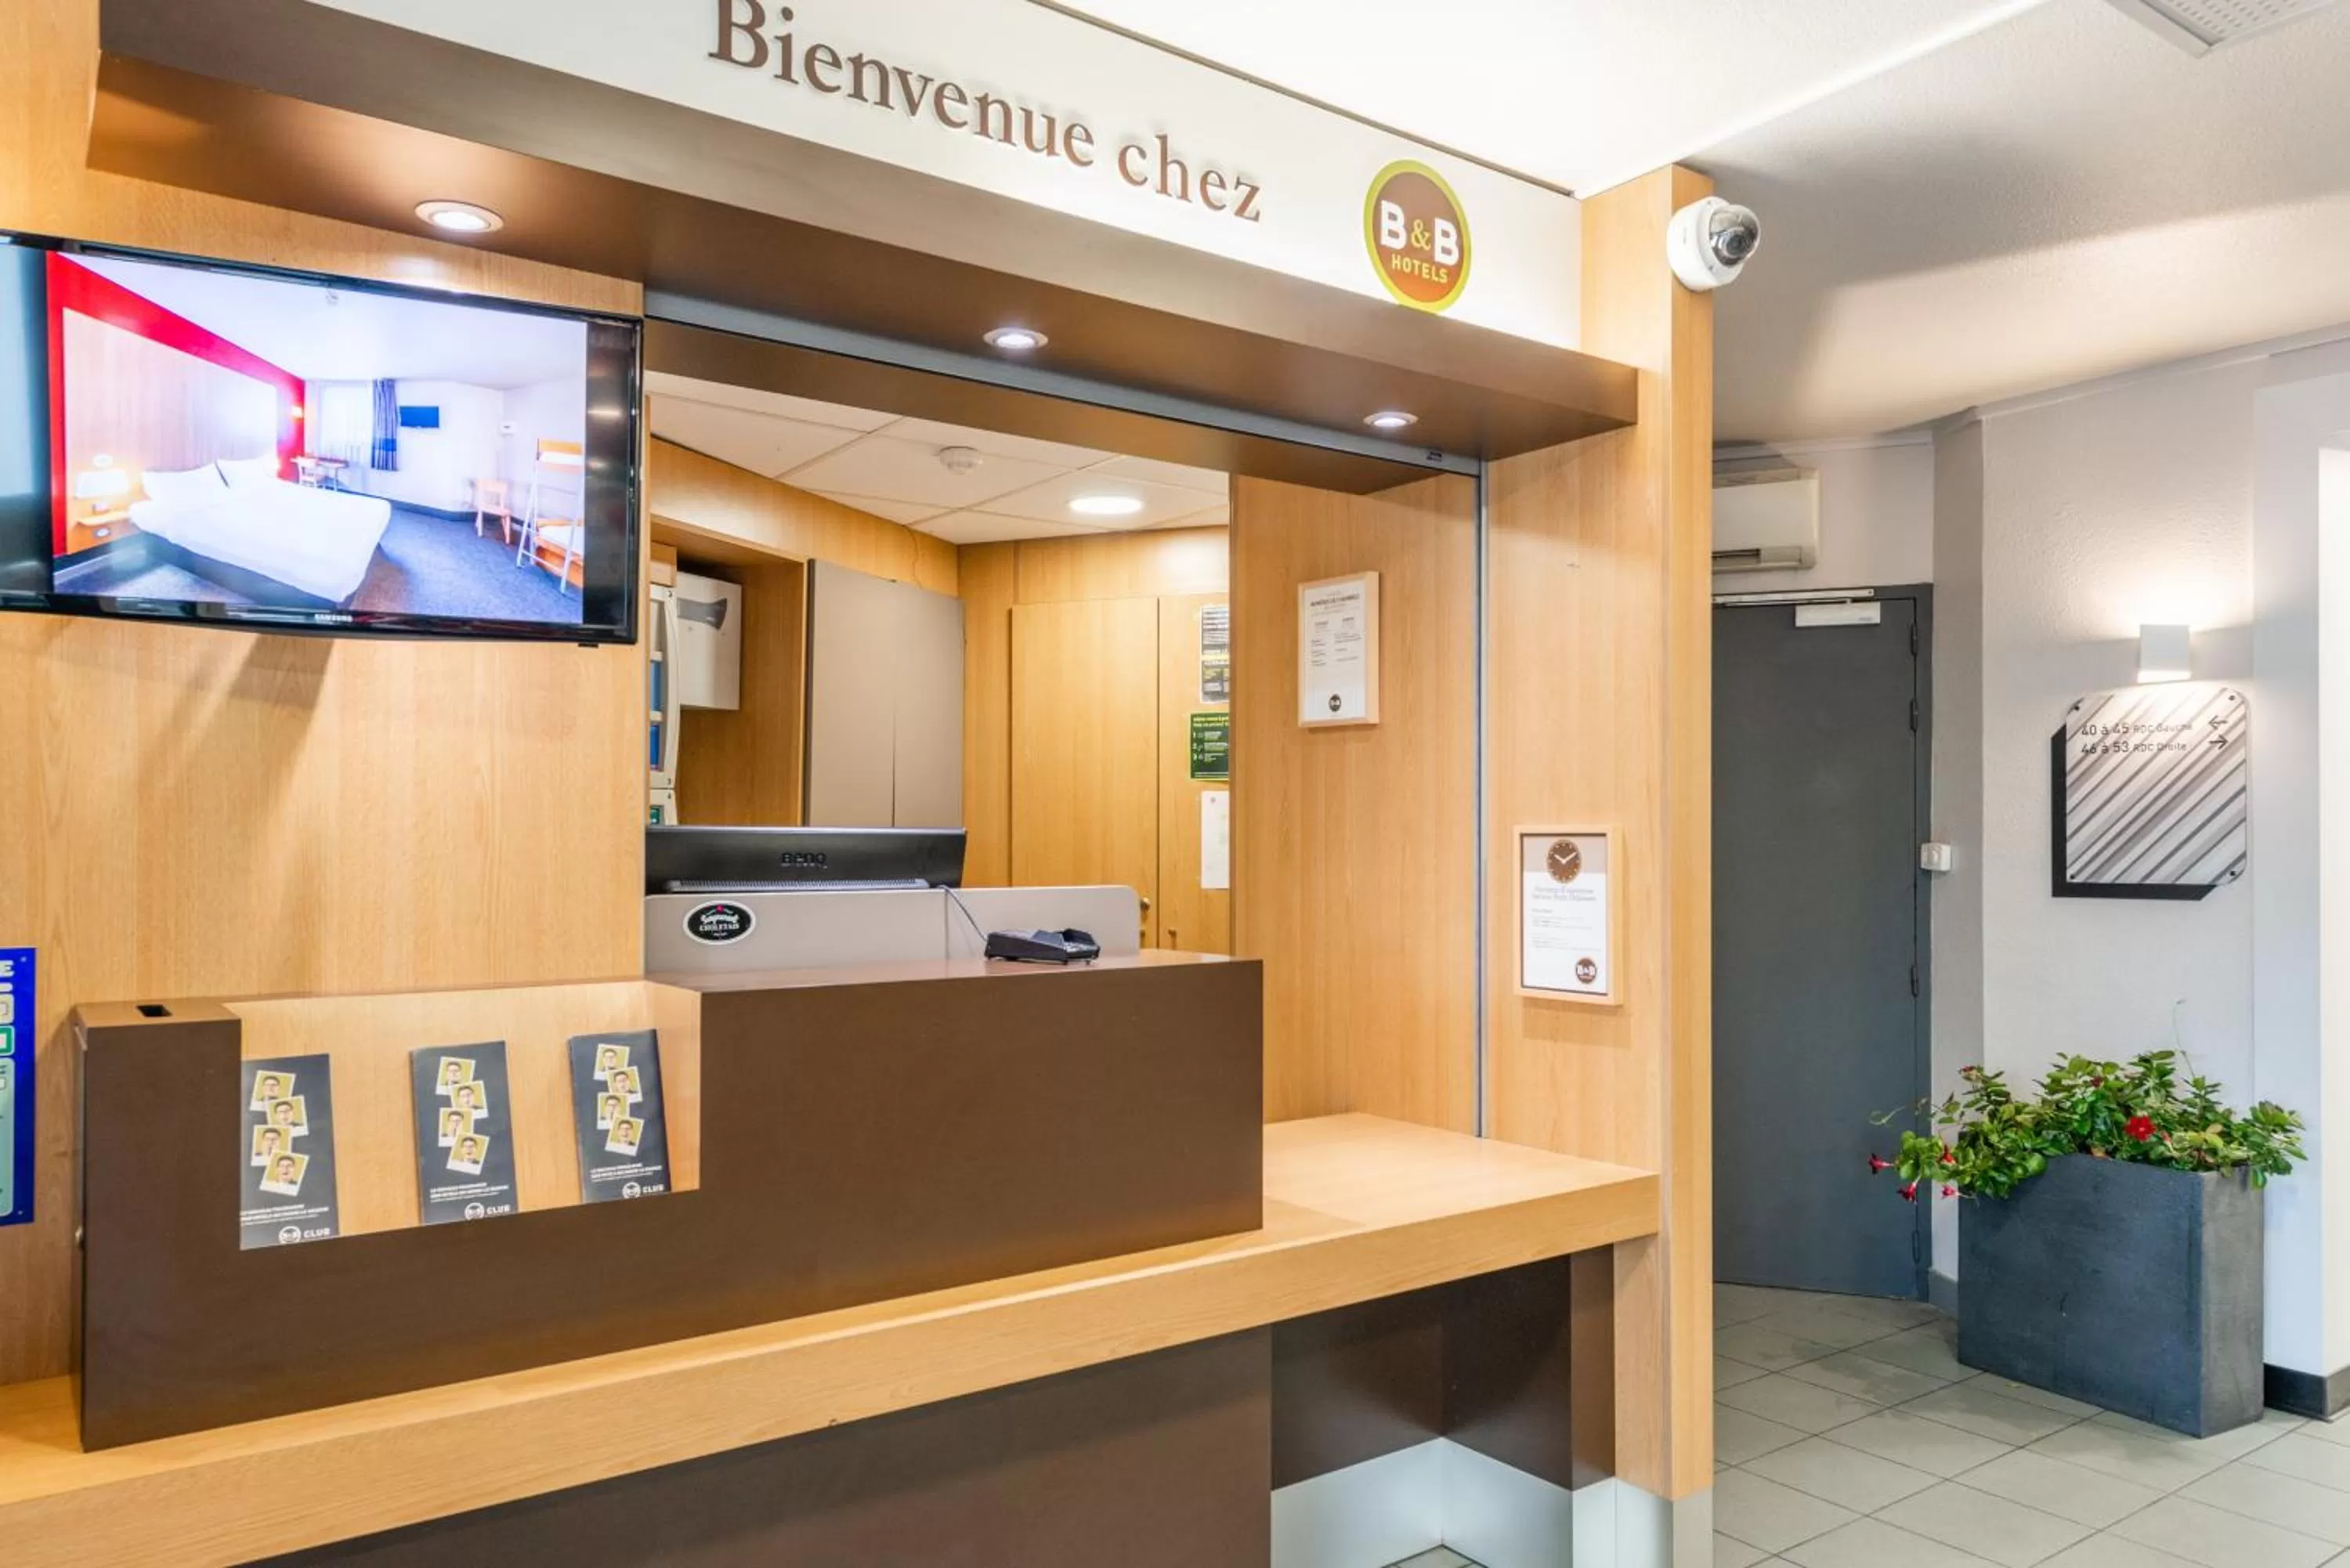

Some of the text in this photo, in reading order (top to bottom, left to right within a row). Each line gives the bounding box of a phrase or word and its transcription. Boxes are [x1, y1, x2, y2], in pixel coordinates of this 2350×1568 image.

[707, 0, 1262, 223] Bienvenue chez
[1379, 200, 1460, 266] B&B
[1391, 253, 1449, 284] HOTELS
[2081, 723, 2098, 736] 40
[2101, 723, 2110, 736] à
[2113, 722, 2130, 735] 45
[2081, 742, 2098, 754] 46
[2113, 740, 2130, 753] 53
[486, 1204, 512, 1216] CLUB
[303, 1227, 331, 1239] CLUB
